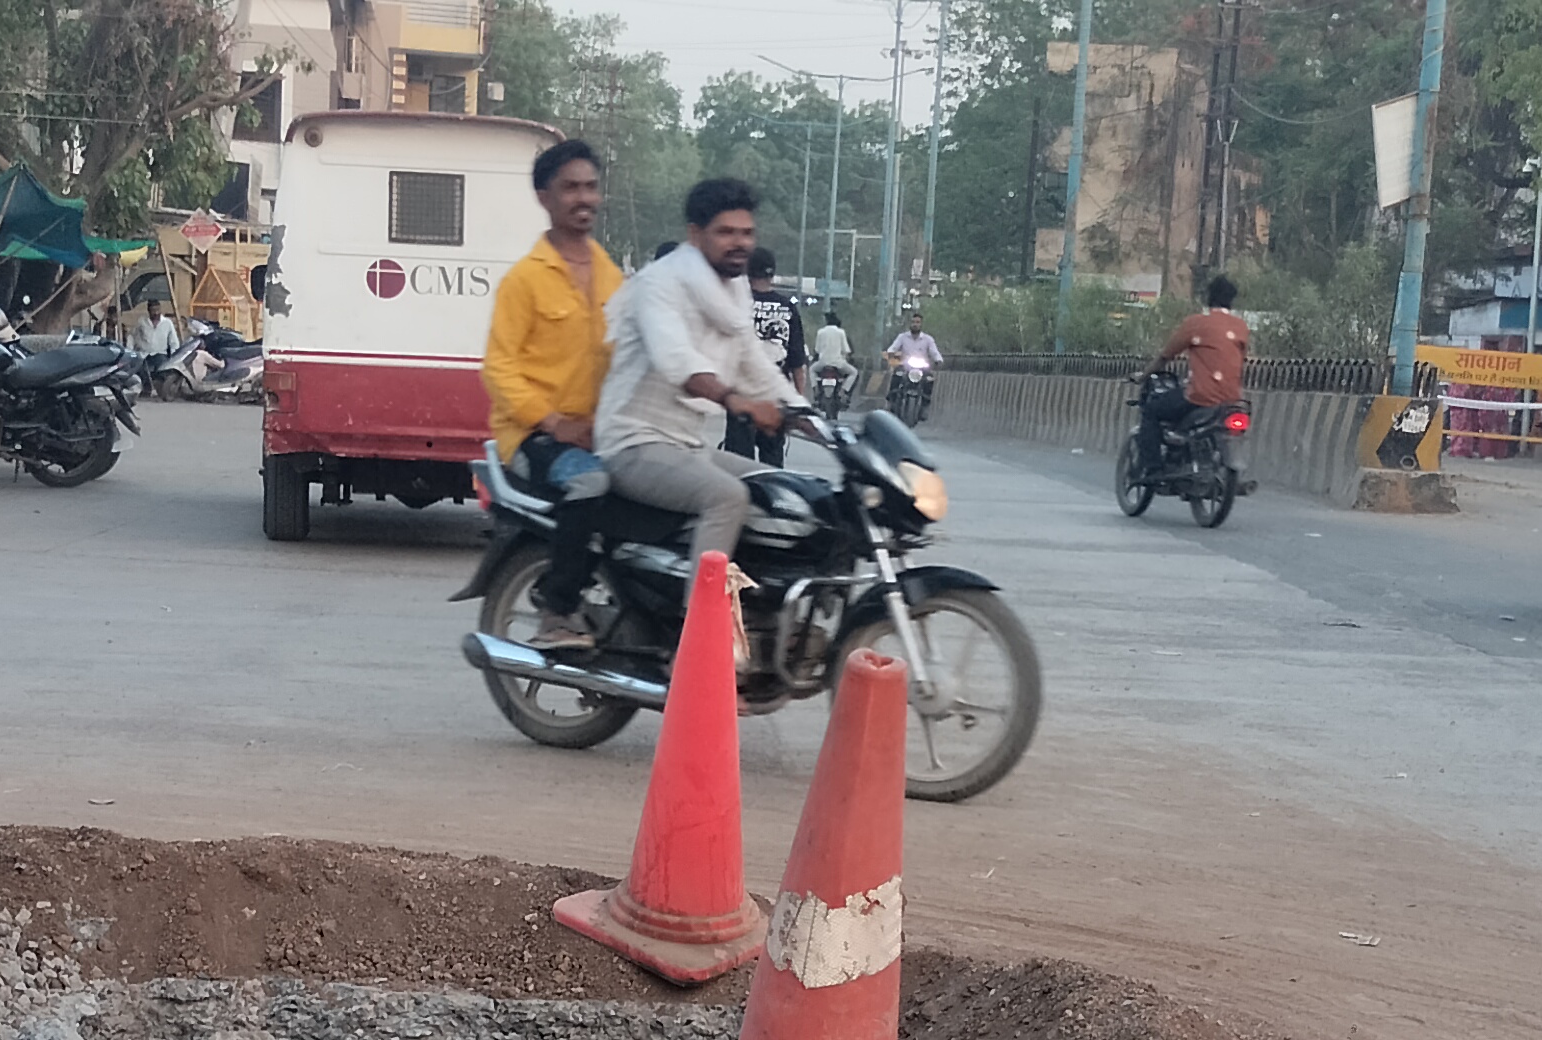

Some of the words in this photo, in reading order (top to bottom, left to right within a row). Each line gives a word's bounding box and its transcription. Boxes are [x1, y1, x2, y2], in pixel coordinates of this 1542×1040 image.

[410, 264, 490, 297] CMS
[753, 301, 781, 311] AST
[1456, 352, 1522, 372] सावधान
